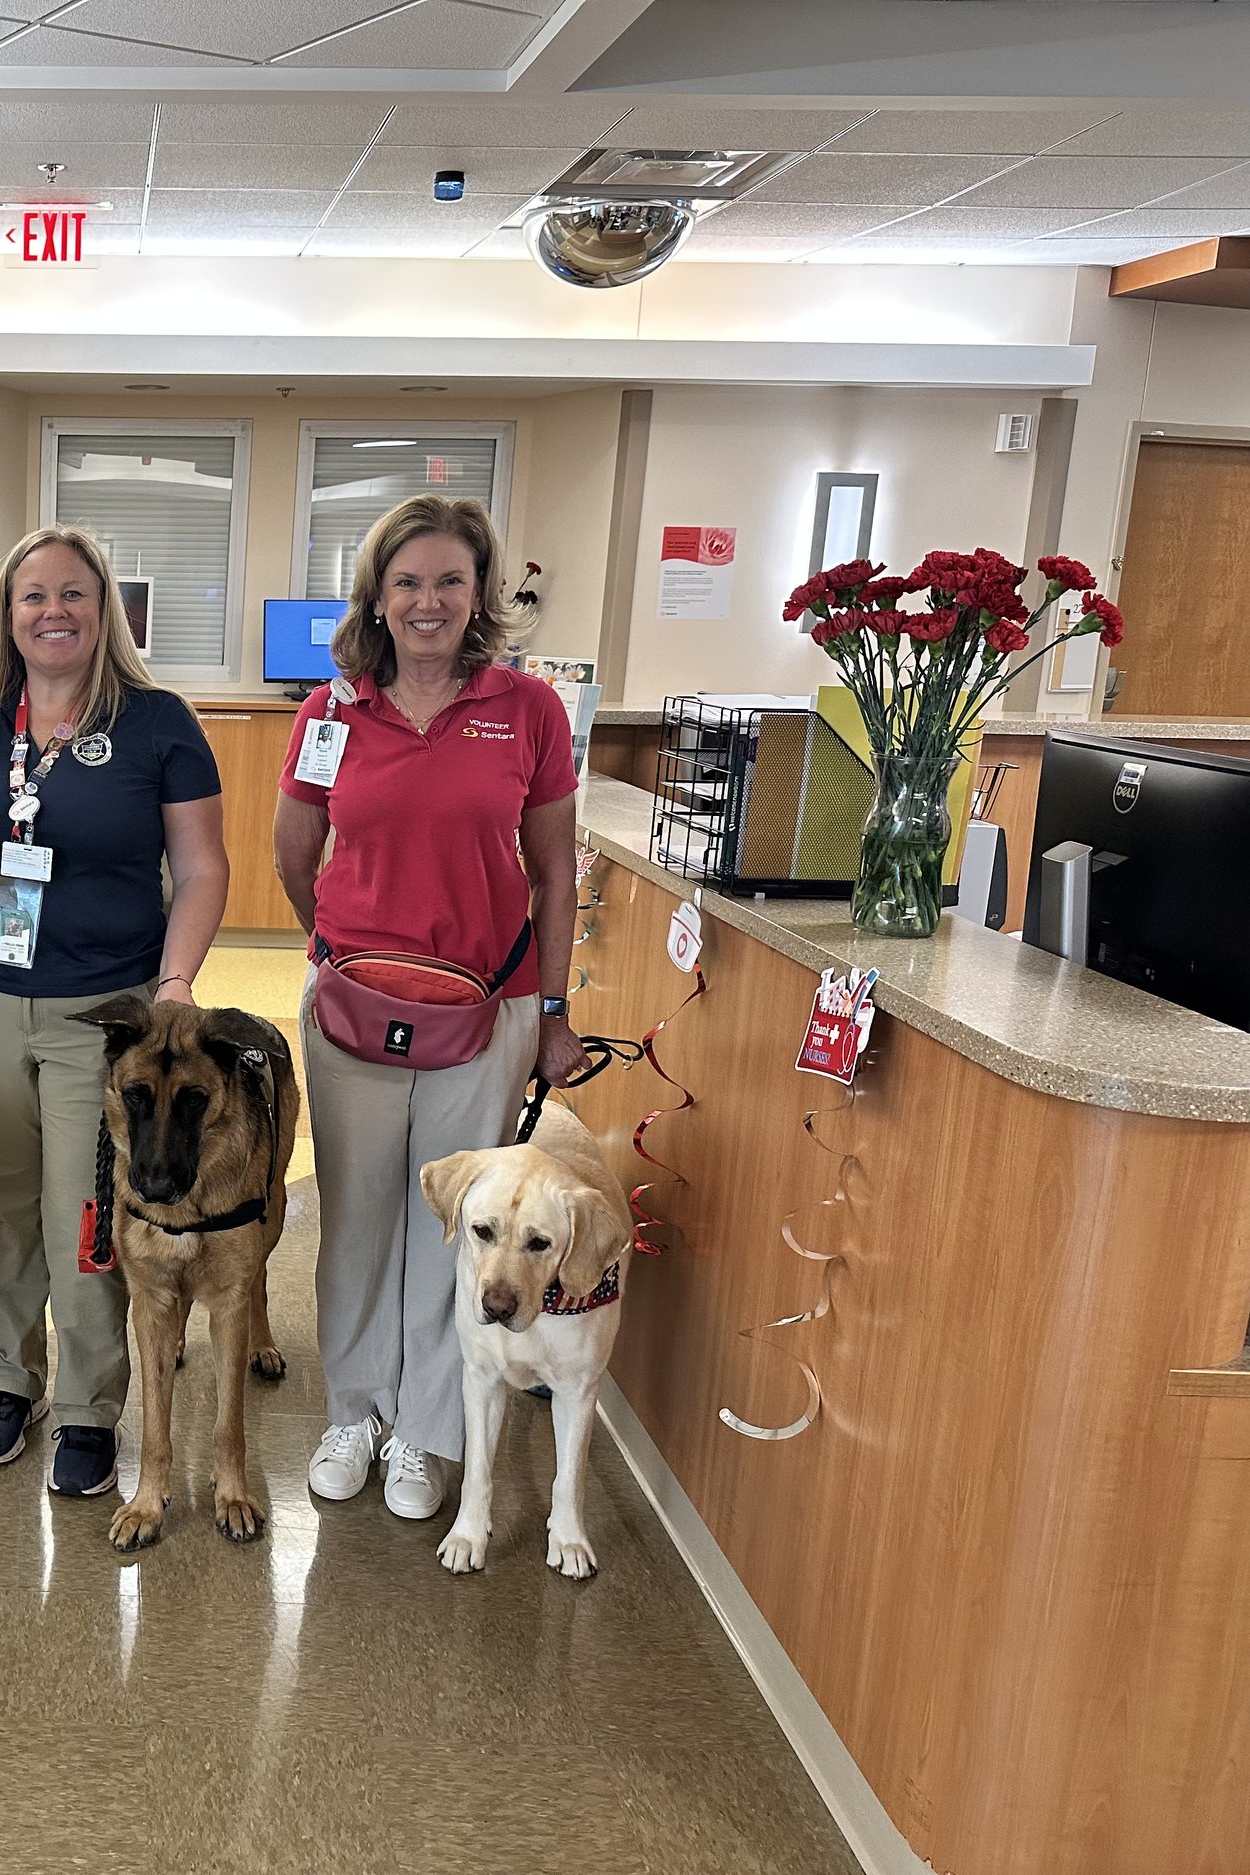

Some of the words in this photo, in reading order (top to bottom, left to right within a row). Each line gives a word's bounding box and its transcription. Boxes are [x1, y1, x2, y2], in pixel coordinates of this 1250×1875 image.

[23, 212, 86, 261] EXIT
[469, 719, 509, 729] VOLUNTEER
[481, 731, 515, 740] Sentara
[1116, 785, 1135, 799] DELL
[811, 1020, 830, 1036] Thank
[810, 1036, 824, 1048] you
[803, 1047, 830, 1065] NURSES!
